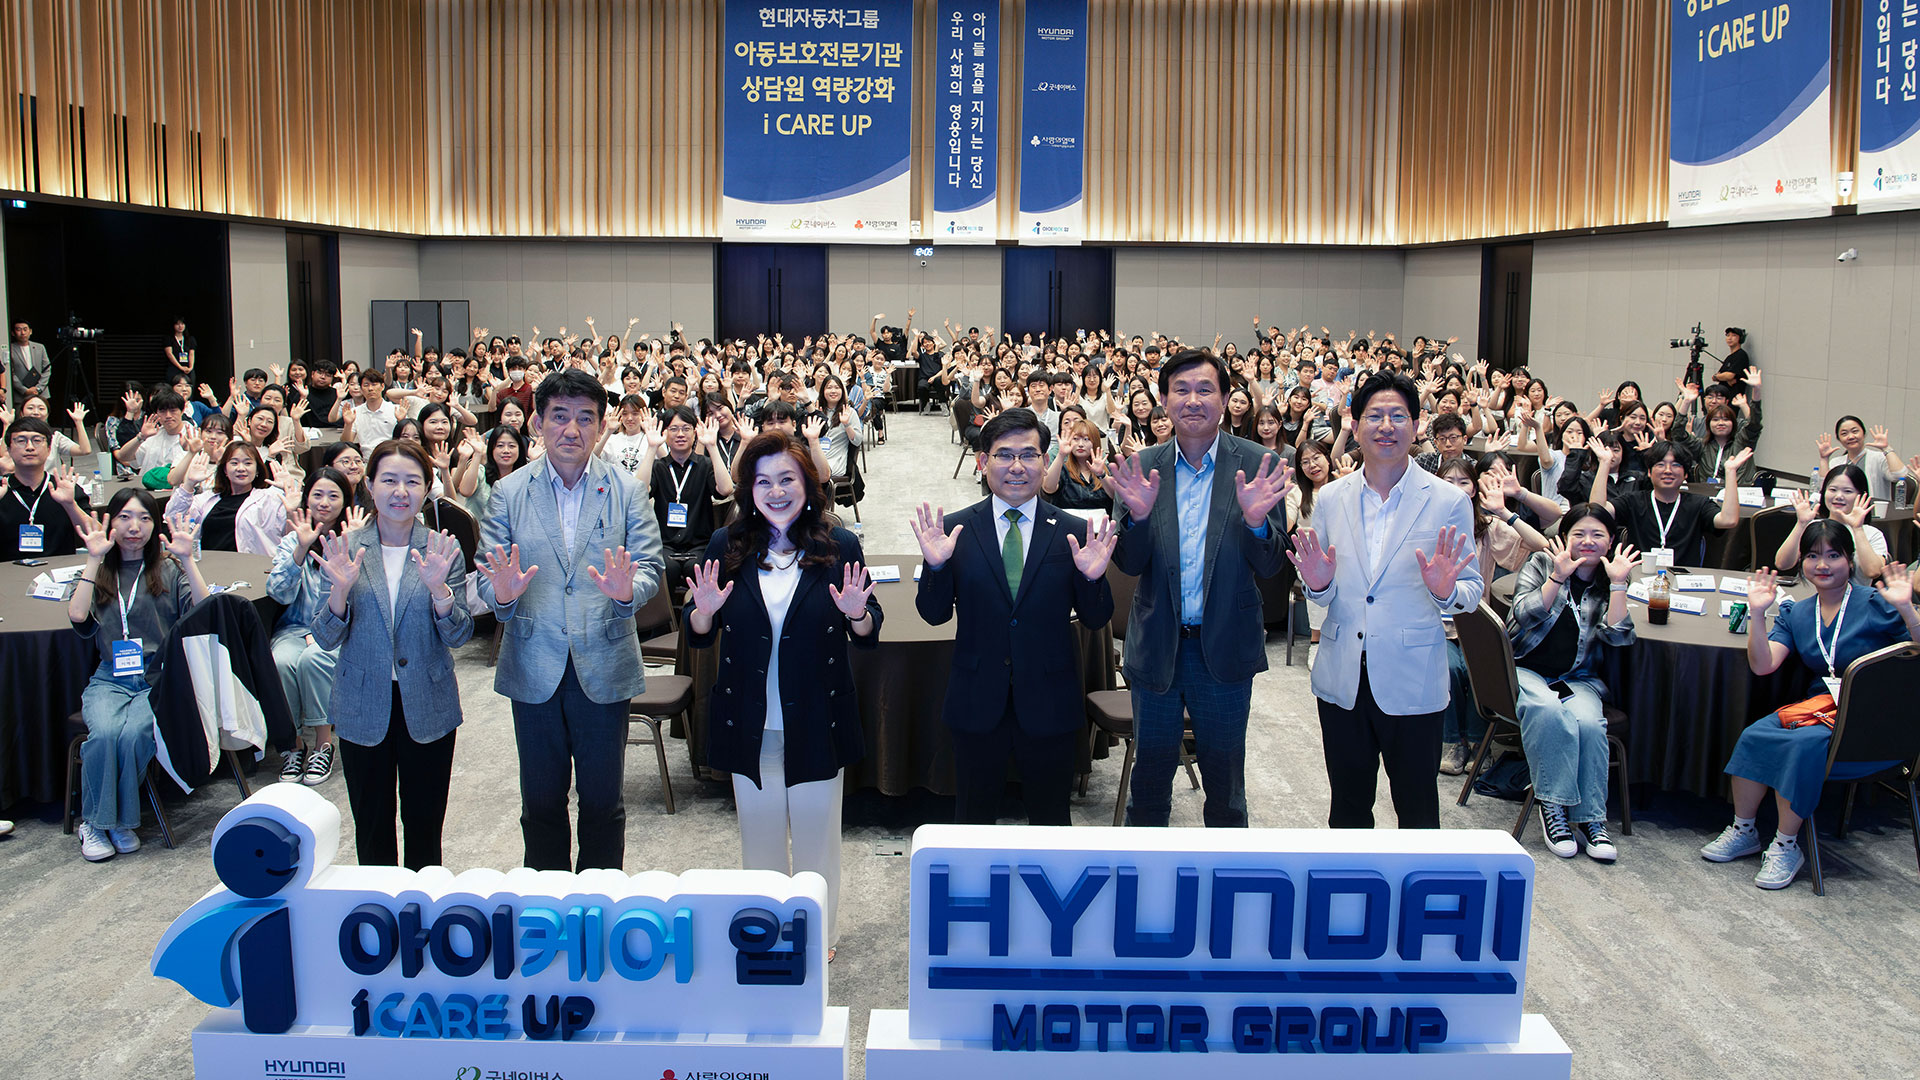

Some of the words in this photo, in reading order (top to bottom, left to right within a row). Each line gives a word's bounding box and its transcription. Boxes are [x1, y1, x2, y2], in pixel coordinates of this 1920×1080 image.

[758, 8, 880, 29] 현대자동차그룹
[951, 11, 964, 41] 우리
[972, 12, 986, 56] 아이들
[1698, 30, 1704, 62] i
[1707, 12, 1756, 58] CARE
[1762, 4, 1790, 43] UP
[734, 41, 903, 68] 아동보호전문기관
[950, 48, 964, 96] 사회의
[1900, 38, 1918, 102] 당신
[741, 76, 805, 103] 상담원
[811, 76, 895, 104] 역량강화
[763, 113, 769, 135] i
[776, 113, 834, 135] CARE
[842, 114, 872, 136] UP
[948, 104, 962, 188] 영웅입니다
[970, 100, 984, 150] 지키는
[970, 156, 984, 189] 당신
[928, 864, 1525, 962] HYUNDAI
[338, 902, 694, 984] 아이케어
[728, 907, 807, 985] 업
[351, 989, 370, 1037] i
[373, 992, 510, 1040] CARE
[521, 994, 595, 1041] UP
[992, 1003, 1210, 1053] MOTOR
[1232, 1006, 1449, 1054] GROUP
[265, 1060, 345, 1074] HYUNDAI
